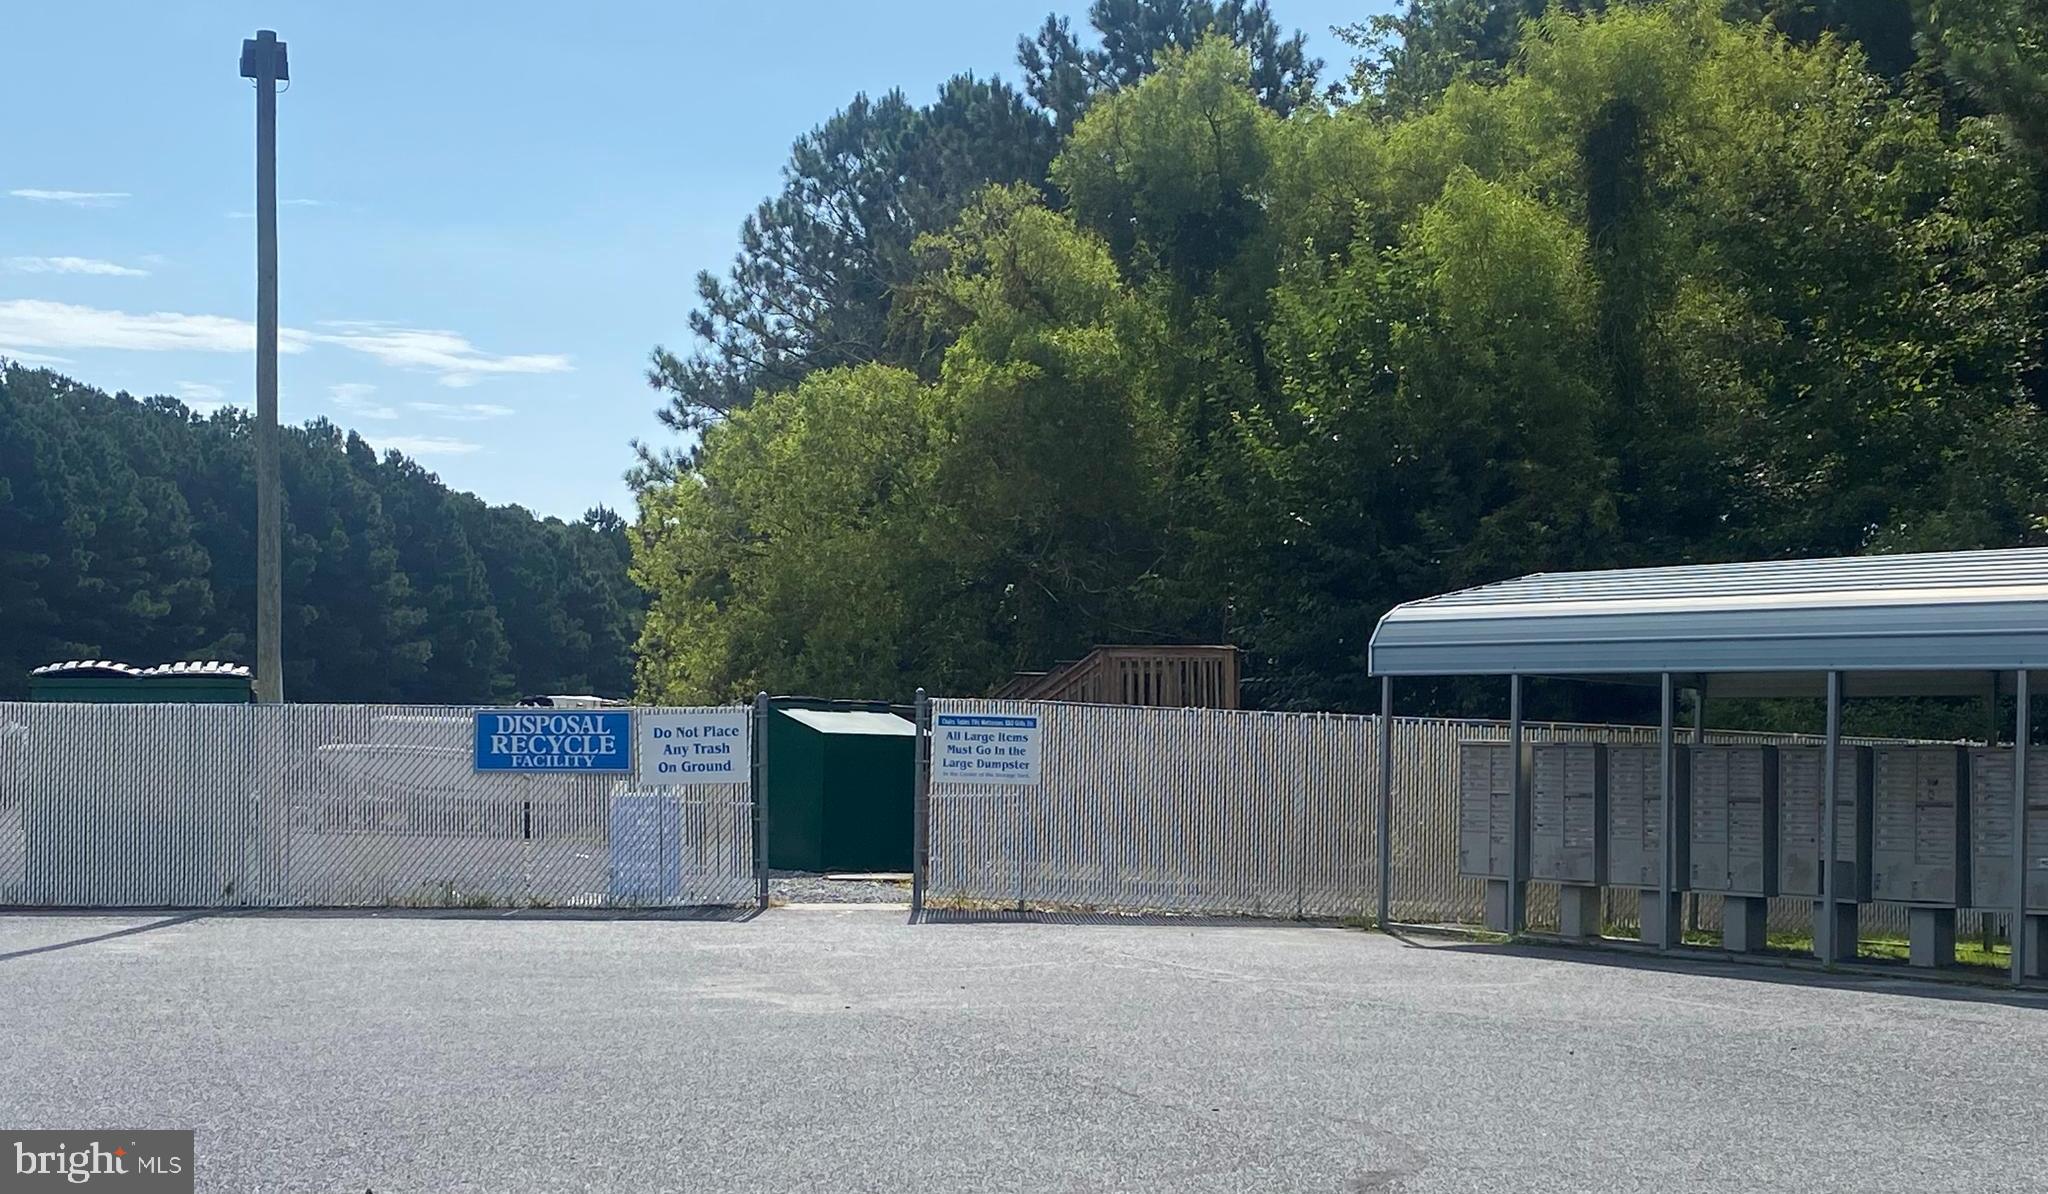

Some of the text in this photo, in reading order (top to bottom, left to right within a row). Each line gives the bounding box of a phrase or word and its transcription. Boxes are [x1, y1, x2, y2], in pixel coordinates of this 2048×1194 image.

[496, 715, 611, 735] DISPOSAL
[653, 726, 739, 739] Do Not Place
[946, 731, 1028, 743] All Large Items
[490, 735, 616, 755] RECYCLE
[663, 744, 730, 757] Any Trash
[947, 745, 1027, 756] Must Go In the
[511, 755, 596, 768] FACILITY
[658, 761, 677, 773] On
[943, 758, 1030, 771] Large Dumpster
